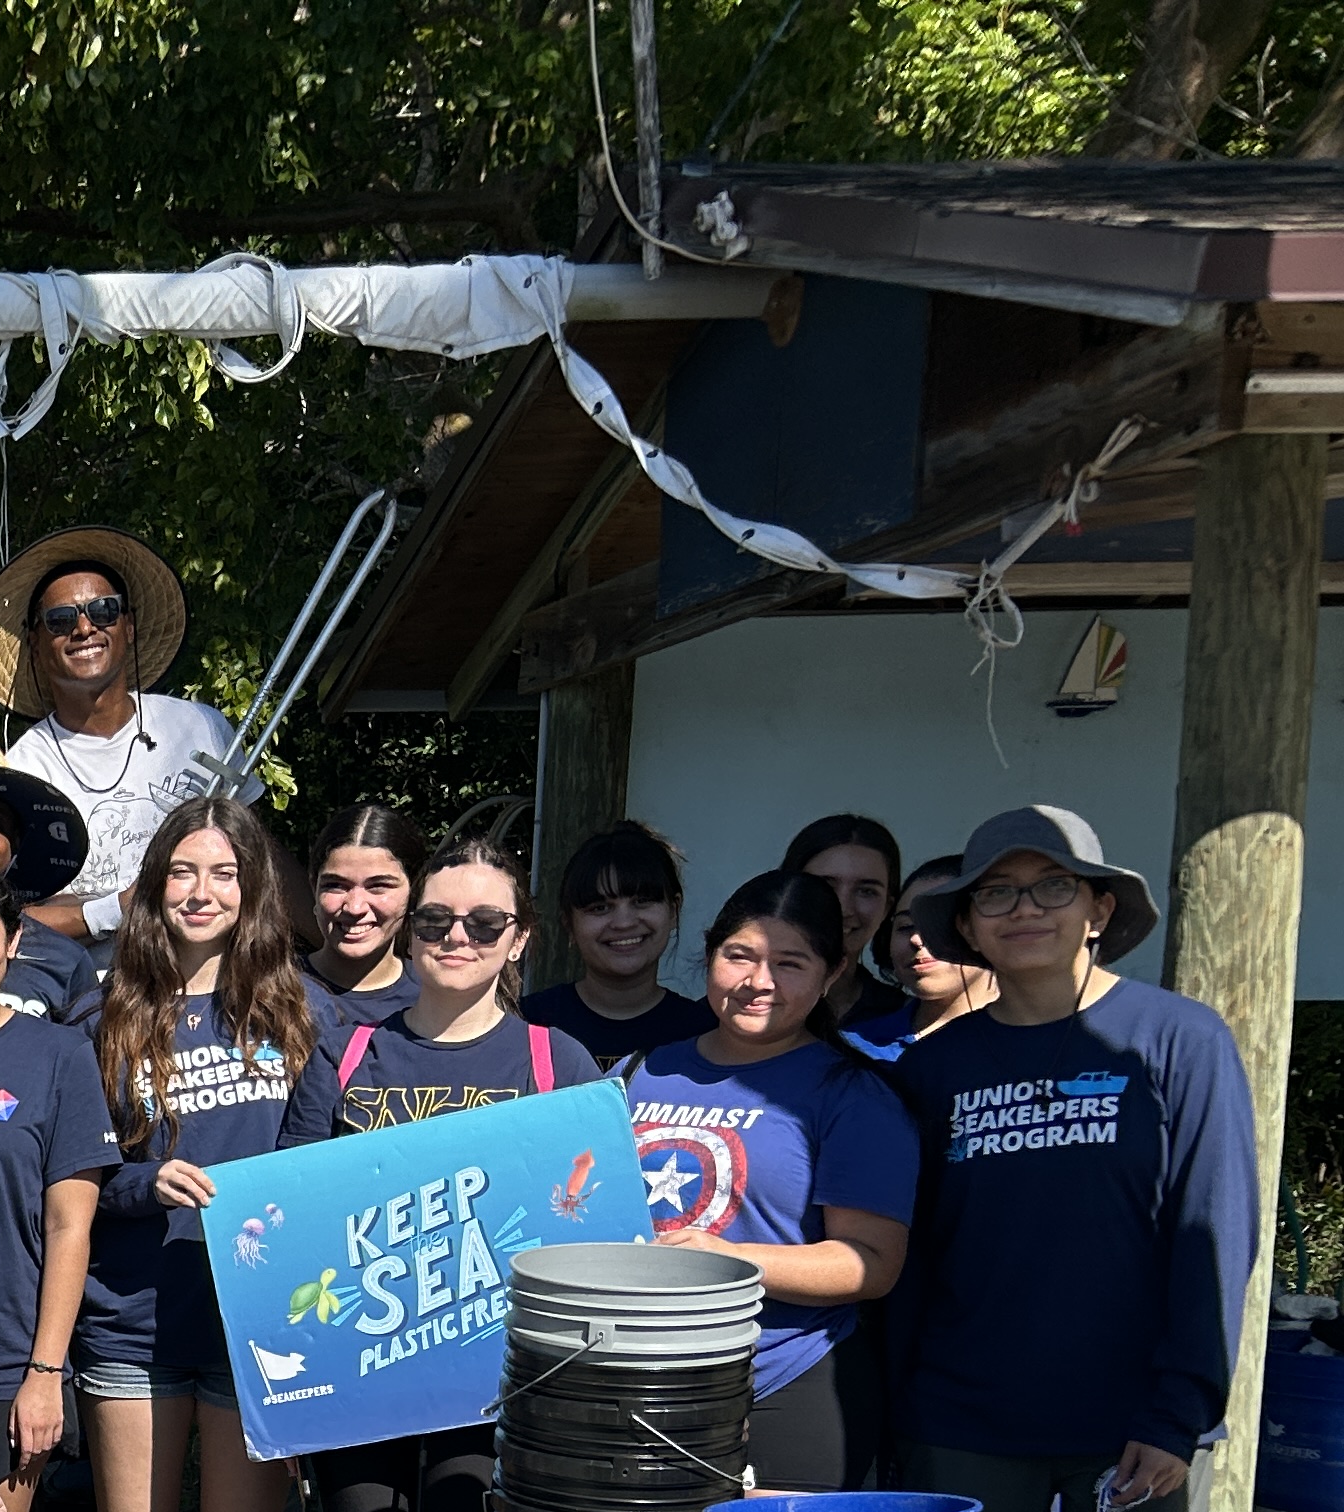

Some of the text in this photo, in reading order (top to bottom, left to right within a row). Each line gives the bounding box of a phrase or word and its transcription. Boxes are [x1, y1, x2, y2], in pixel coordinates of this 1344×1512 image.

[950, 1079, 1054, 1122] JUNIOR
[950, 1096, 1119, 1140] SEAKEEPERS
[966, 1121, 1118, 1159] PROGRAM
[346, 1165, 490, 1268] KEEP
[354, 1217, 504, 1336] SEA
[359, 1312, 459, 1377] PLASTIC
[262, 1384, 334, 1406] #SEAKEEPERS
